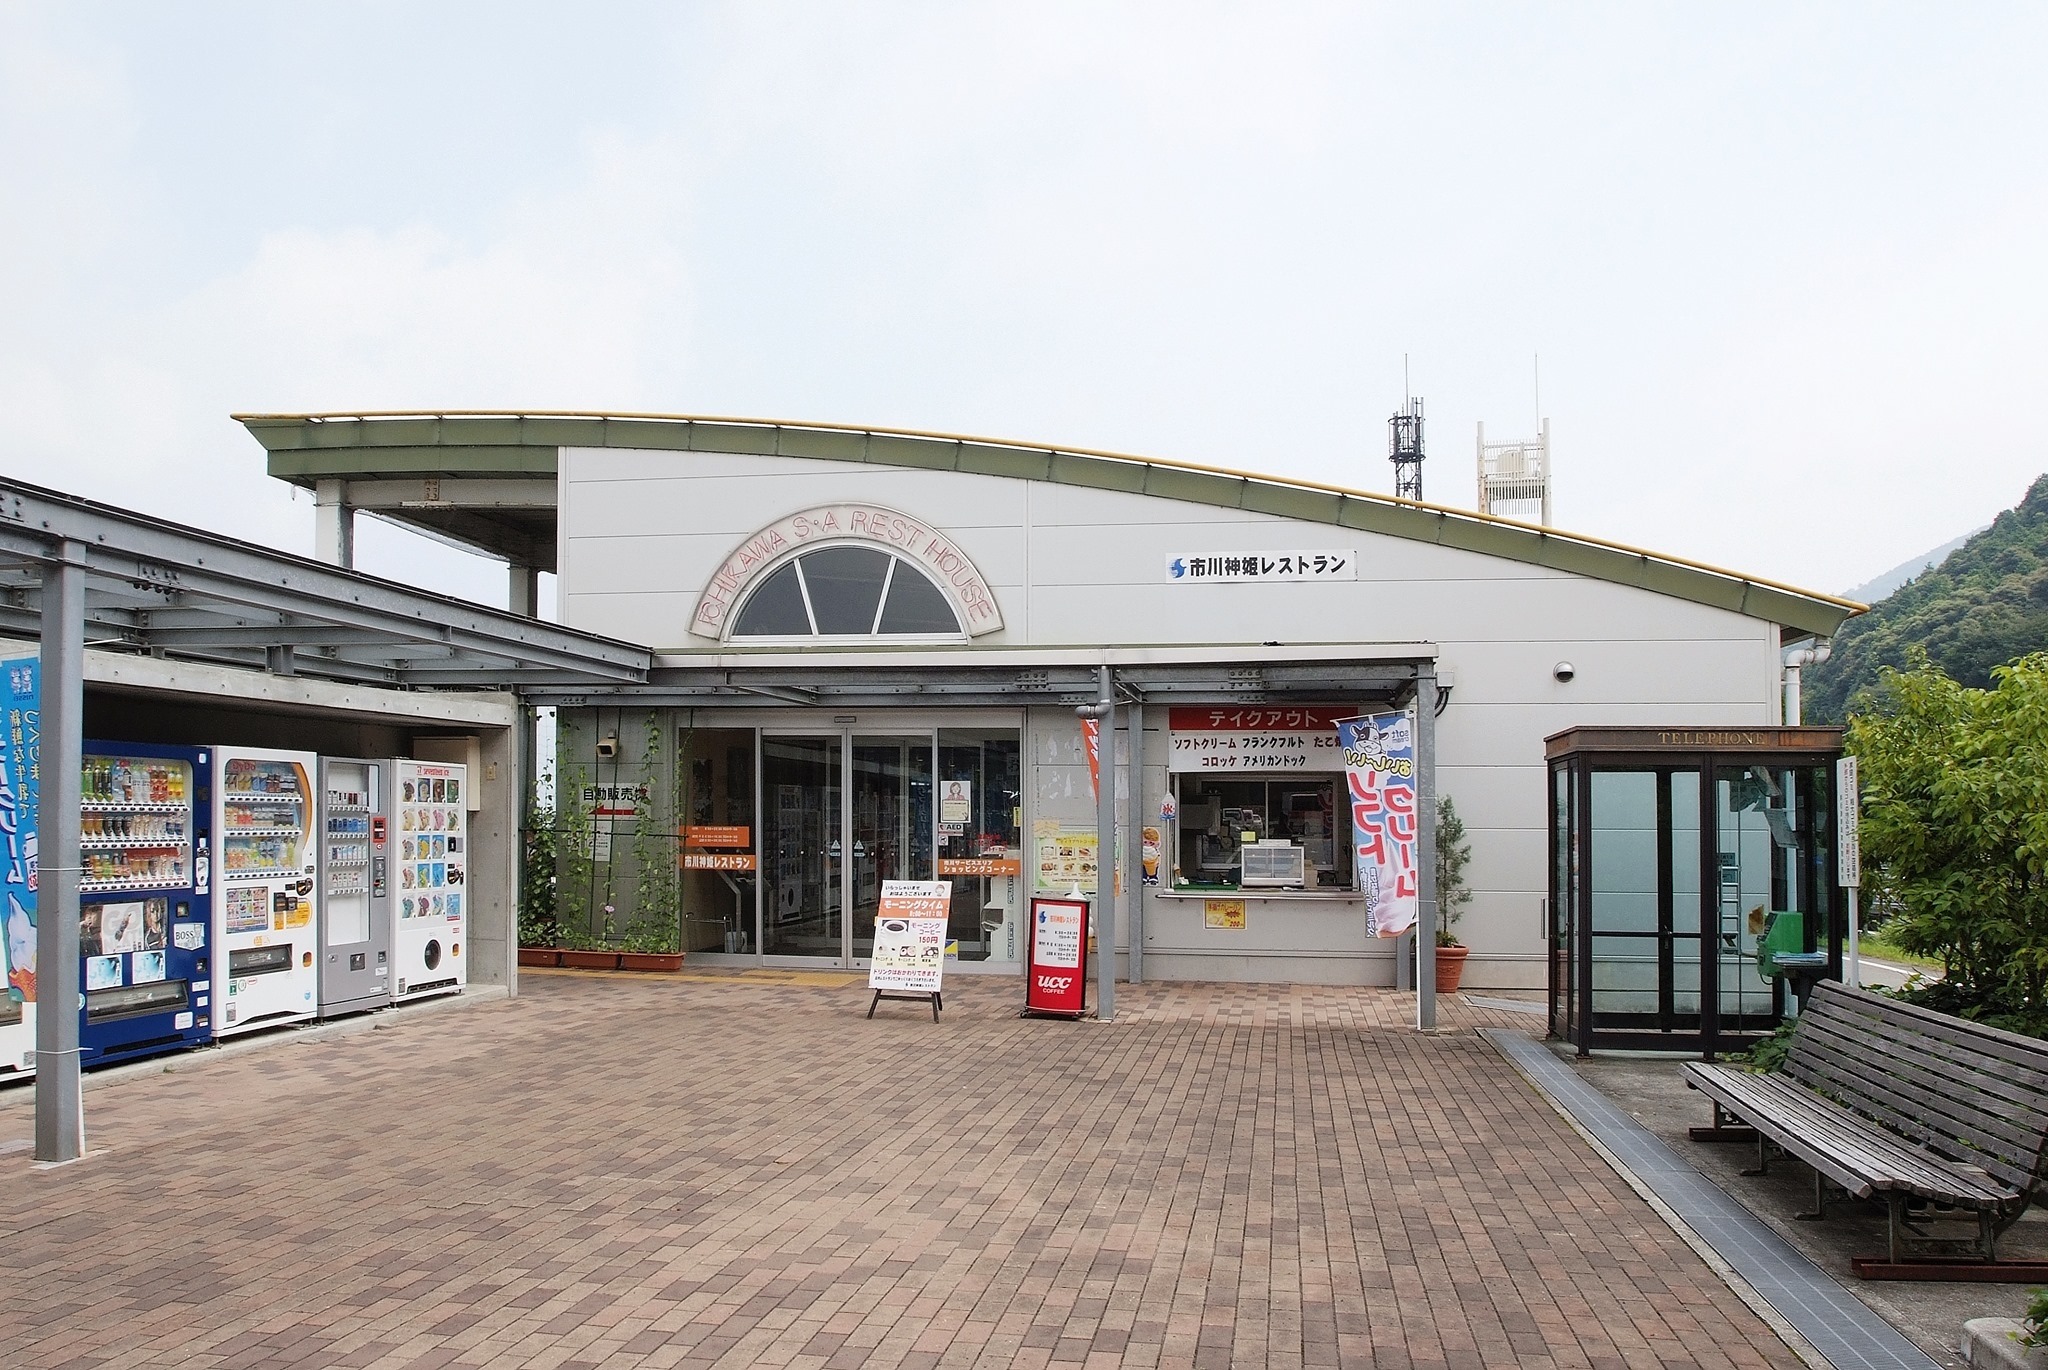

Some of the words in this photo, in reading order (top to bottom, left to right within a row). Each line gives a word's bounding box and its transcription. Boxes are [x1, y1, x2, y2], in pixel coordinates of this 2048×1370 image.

[697, 529, 787, 627] ICHIKAWA
[850, 510, 924, 549] REST
[923, 538, 993, 623] HOUSE
[1189, 555, 1346, 577] 市川神姫レストラン
[1209, 710, 1319, 728] テイクアウト
[1174, 737, 1237, 750] ソフトクリーム
[1242, 736, 1305, 749] フランクフルト
[1658, 732, 1766, 745] TELEPHONE
[1202, 755, 1237, 767] コロッケ
[684, 855, 750, 869] 市川神姫レストラン
[884, 900, 944, 909] モーニングタイム
[175, 930, 194, 940] BOSS
[1038, 975, 1072, 989] UCC
